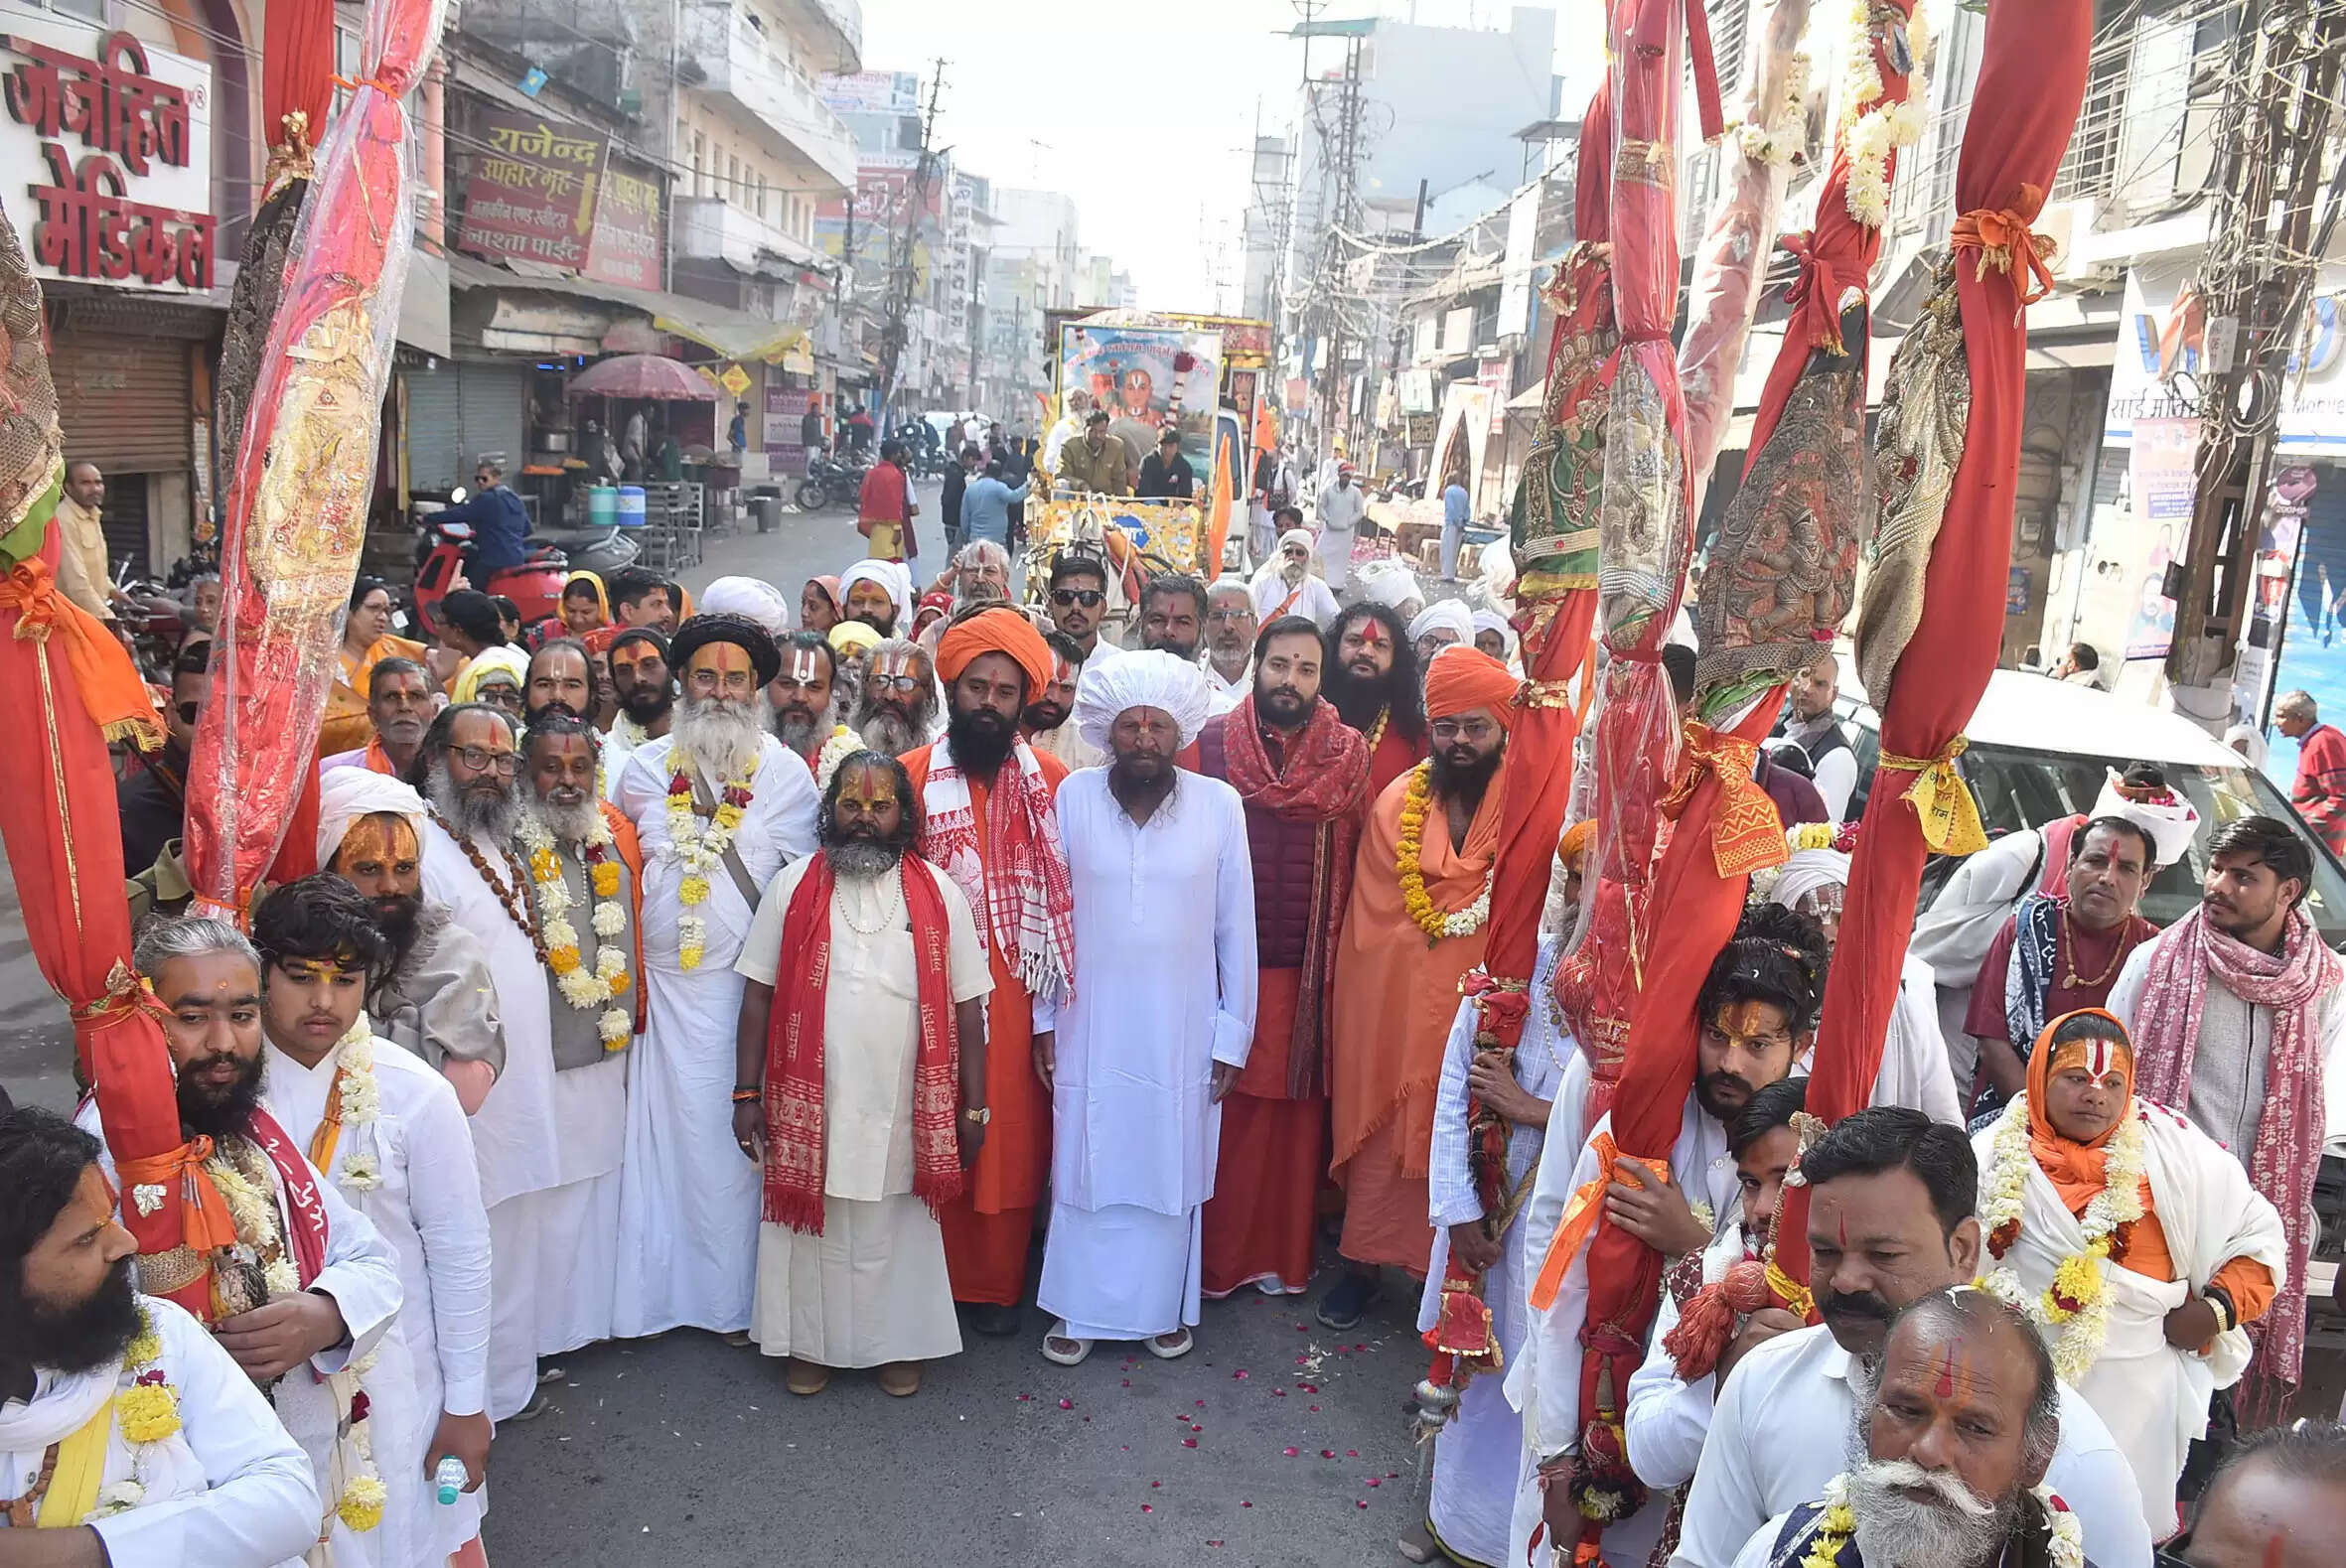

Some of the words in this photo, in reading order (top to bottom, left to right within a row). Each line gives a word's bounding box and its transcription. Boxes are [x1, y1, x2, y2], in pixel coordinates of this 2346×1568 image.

[0, 31, 190, 177] जनहित
[489, 124, 598, 167] राजेन्द्र
[28, 142, 217, 289] मेडिकल
[467, 227, 528, 254] नाश्ता
